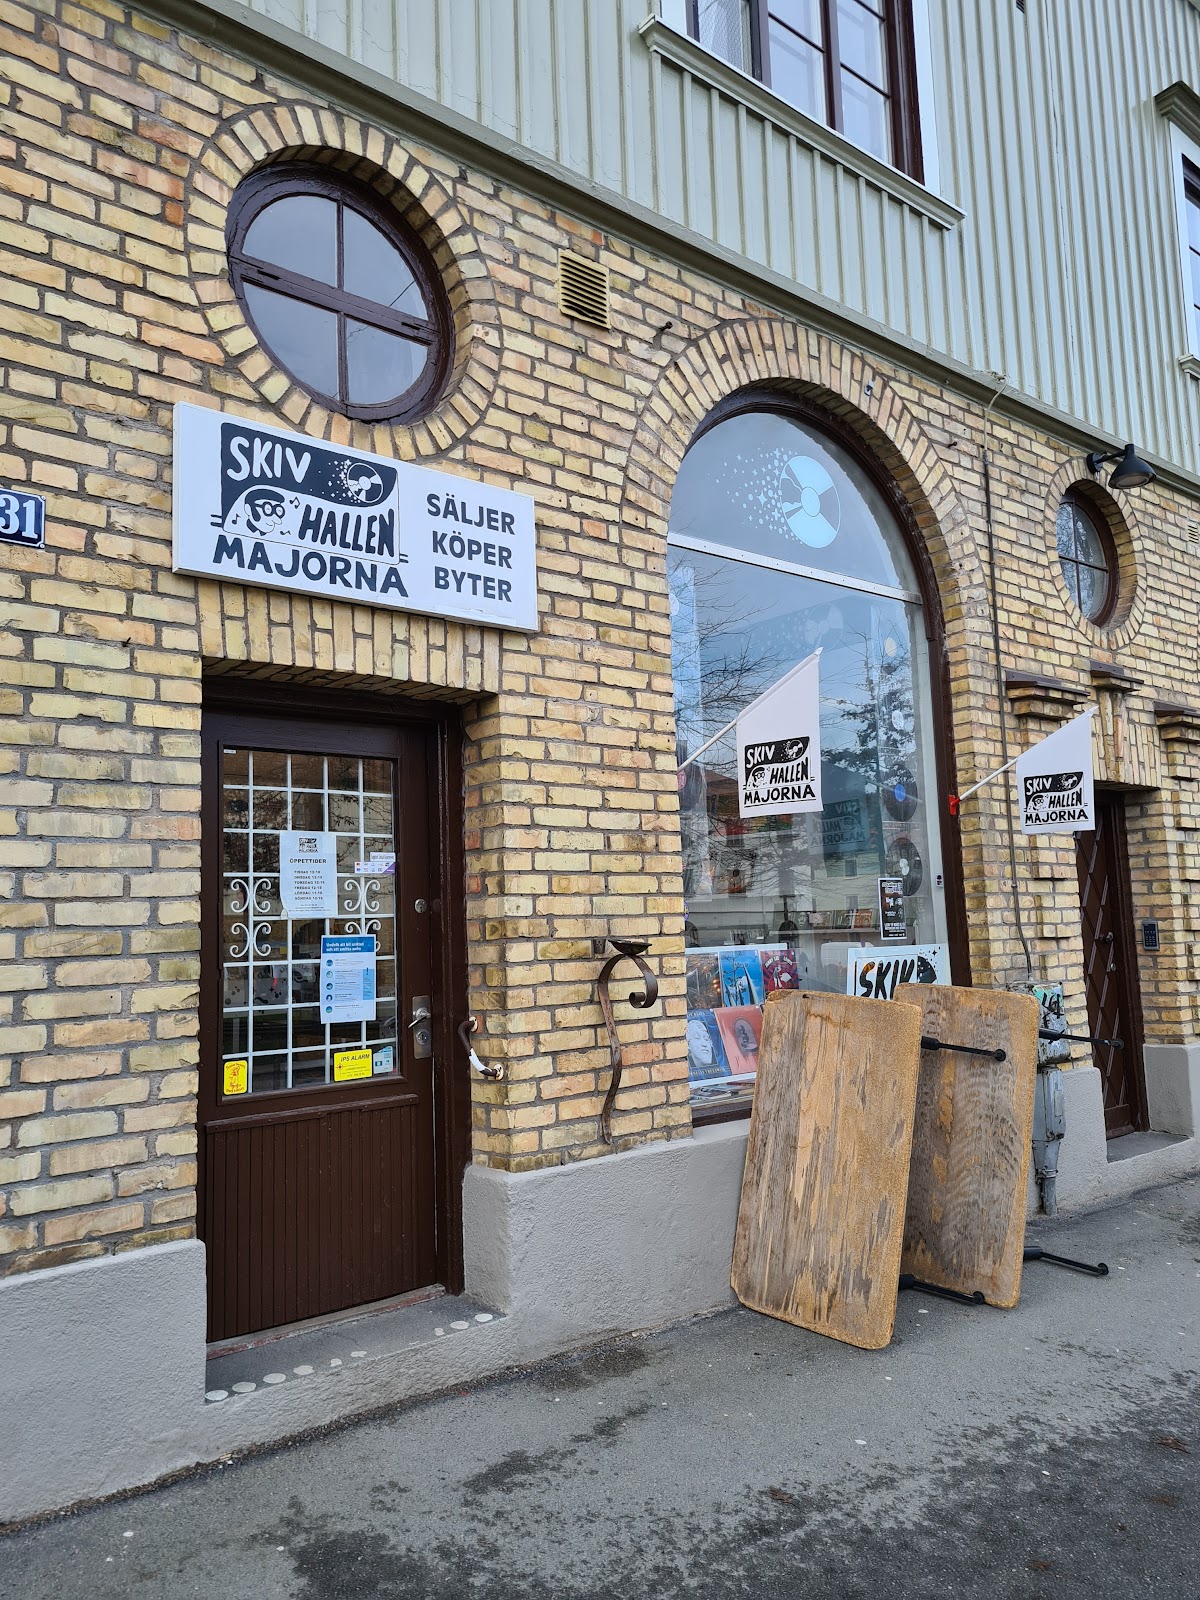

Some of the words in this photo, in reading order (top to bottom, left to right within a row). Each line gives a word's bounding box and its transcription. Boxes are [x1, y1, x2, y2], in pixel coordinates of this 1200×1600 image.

[226, 436, 311, 483] SKIV
[0, 494, 38, 539] 31
[426, 492, 515, 535] SÄLJER
[298, 504, 395, 558] HALLEN
[212, 534, 409, 597] MAJORNA
[432, 530, 513, 569] KÖPER
[434, 566, 512, 602] BYTER
[746, 745, 776, 768] SKIV
[769, 756, 808, 785] HALLEN
[744, 784, 816, 805] MAJORNA
[1026, 777, 1053, 796] SKIV
[1048, 787, 1082, 809] HALLEN
[1025, 808, 1089, 824] MAJORNA
[351, 1053, 370, 1061] ALARM
